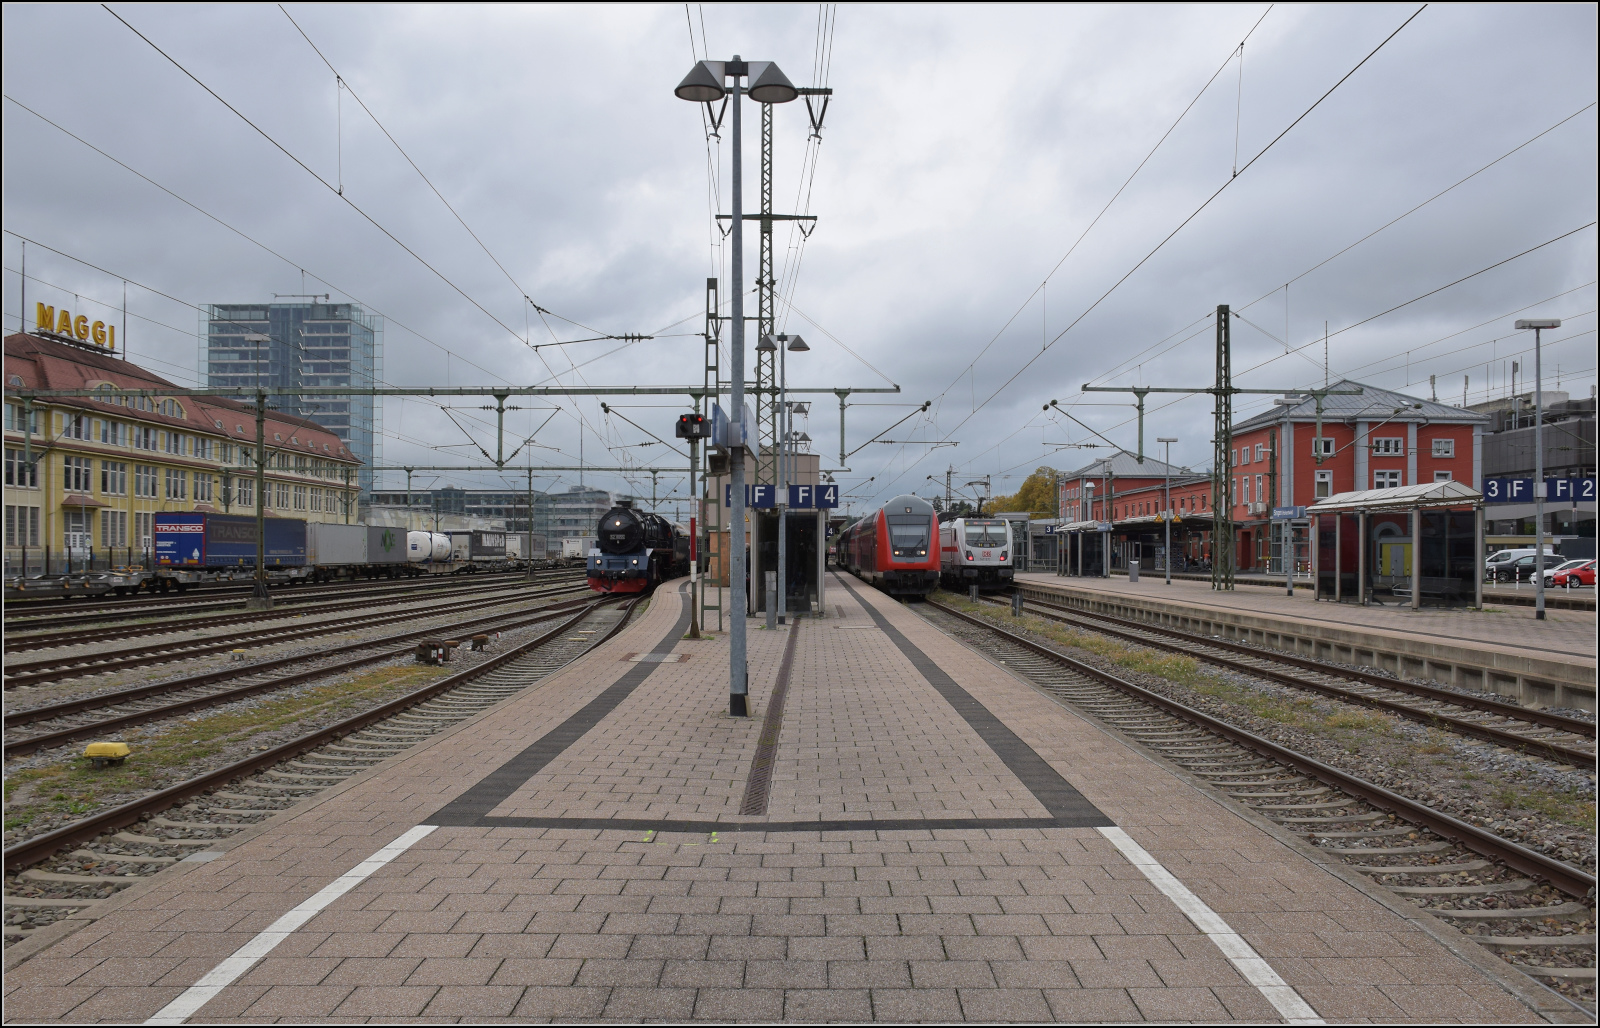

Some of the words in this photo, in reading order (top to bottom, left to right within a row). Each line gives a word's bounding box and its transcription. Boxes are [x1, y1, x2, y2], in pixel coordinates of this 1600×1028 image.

[36, 302, 115, 350] MAGGI
[754, 486, 766, 503] F
[798, 486, 810, 504] F
[824, 486, 836, 504] 4
[1487, 480, 1499, 497] 3
[1512, 480, 1524, 497] F
[1556, 480, 1568, 497] F
[1582, 480, 1593, 497] 2
[828, 527, 834, 535] 4
[1046, 525, 1051, 533] 3
